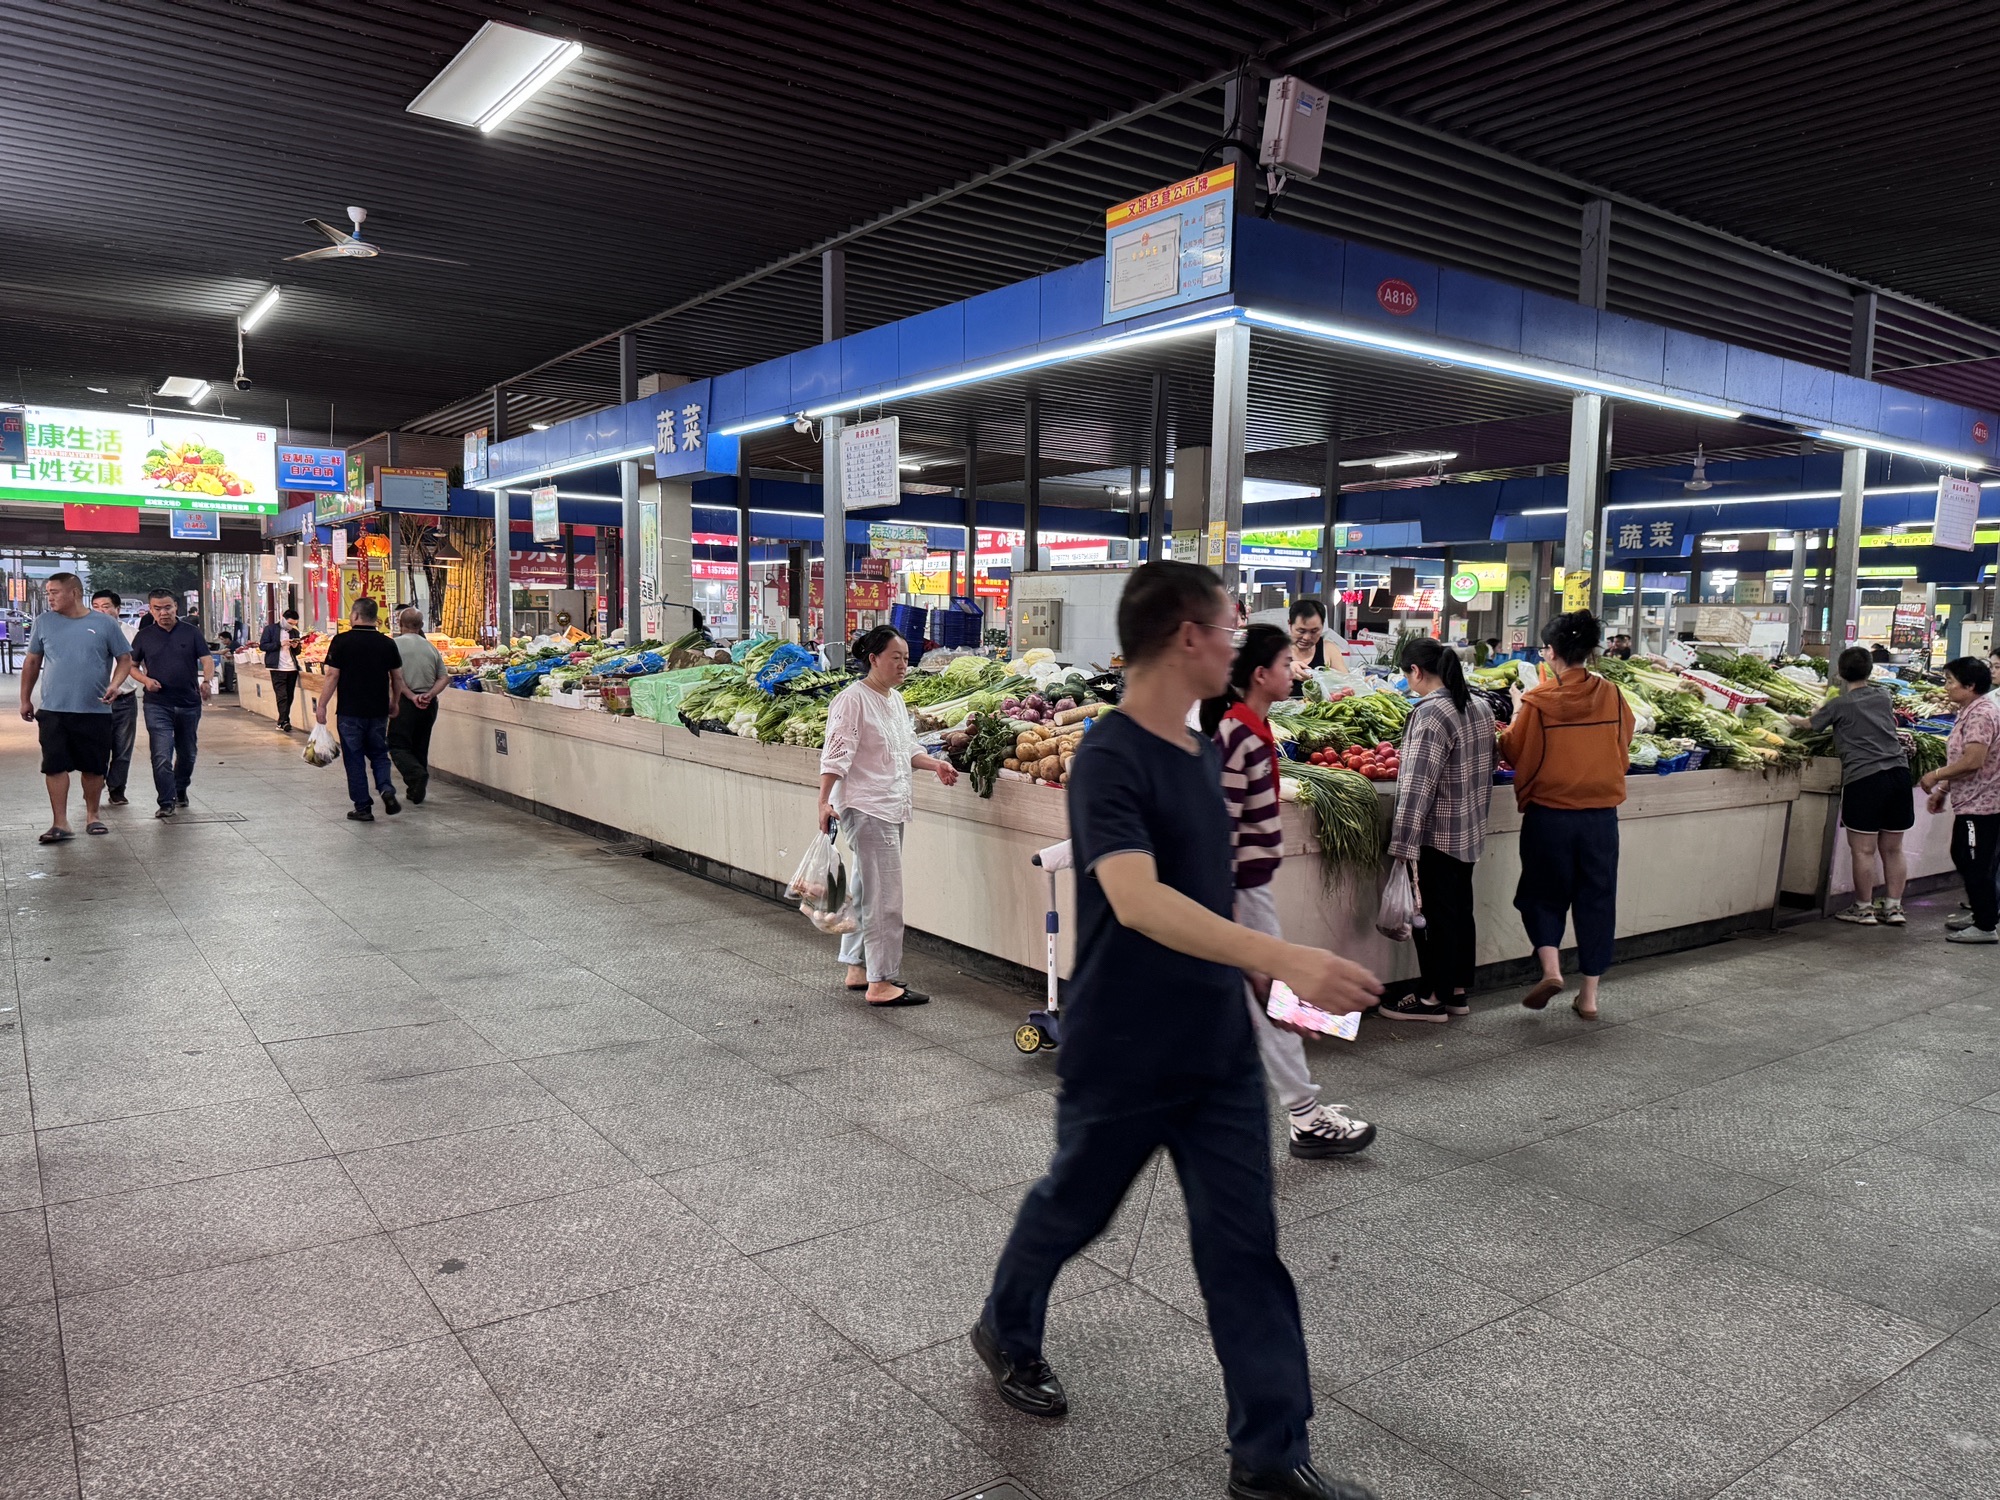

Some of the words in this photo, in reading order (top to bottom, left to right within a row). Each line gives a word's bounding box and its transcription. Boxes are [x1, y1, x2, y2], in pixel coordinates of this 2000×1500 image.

[1128, 177, 1208, 217] 文明经营公示牌
[1384, 288, 1412, 306] A816
[656, 403, 702, 454] 蔬菜
[1974, 426, 1987, 439] A815
[11, 457, 124, 485] 百姓安康
[871, 525, 927, 541] 无敌水果店
[1619, 522, 1674, 549] 蔬菜
